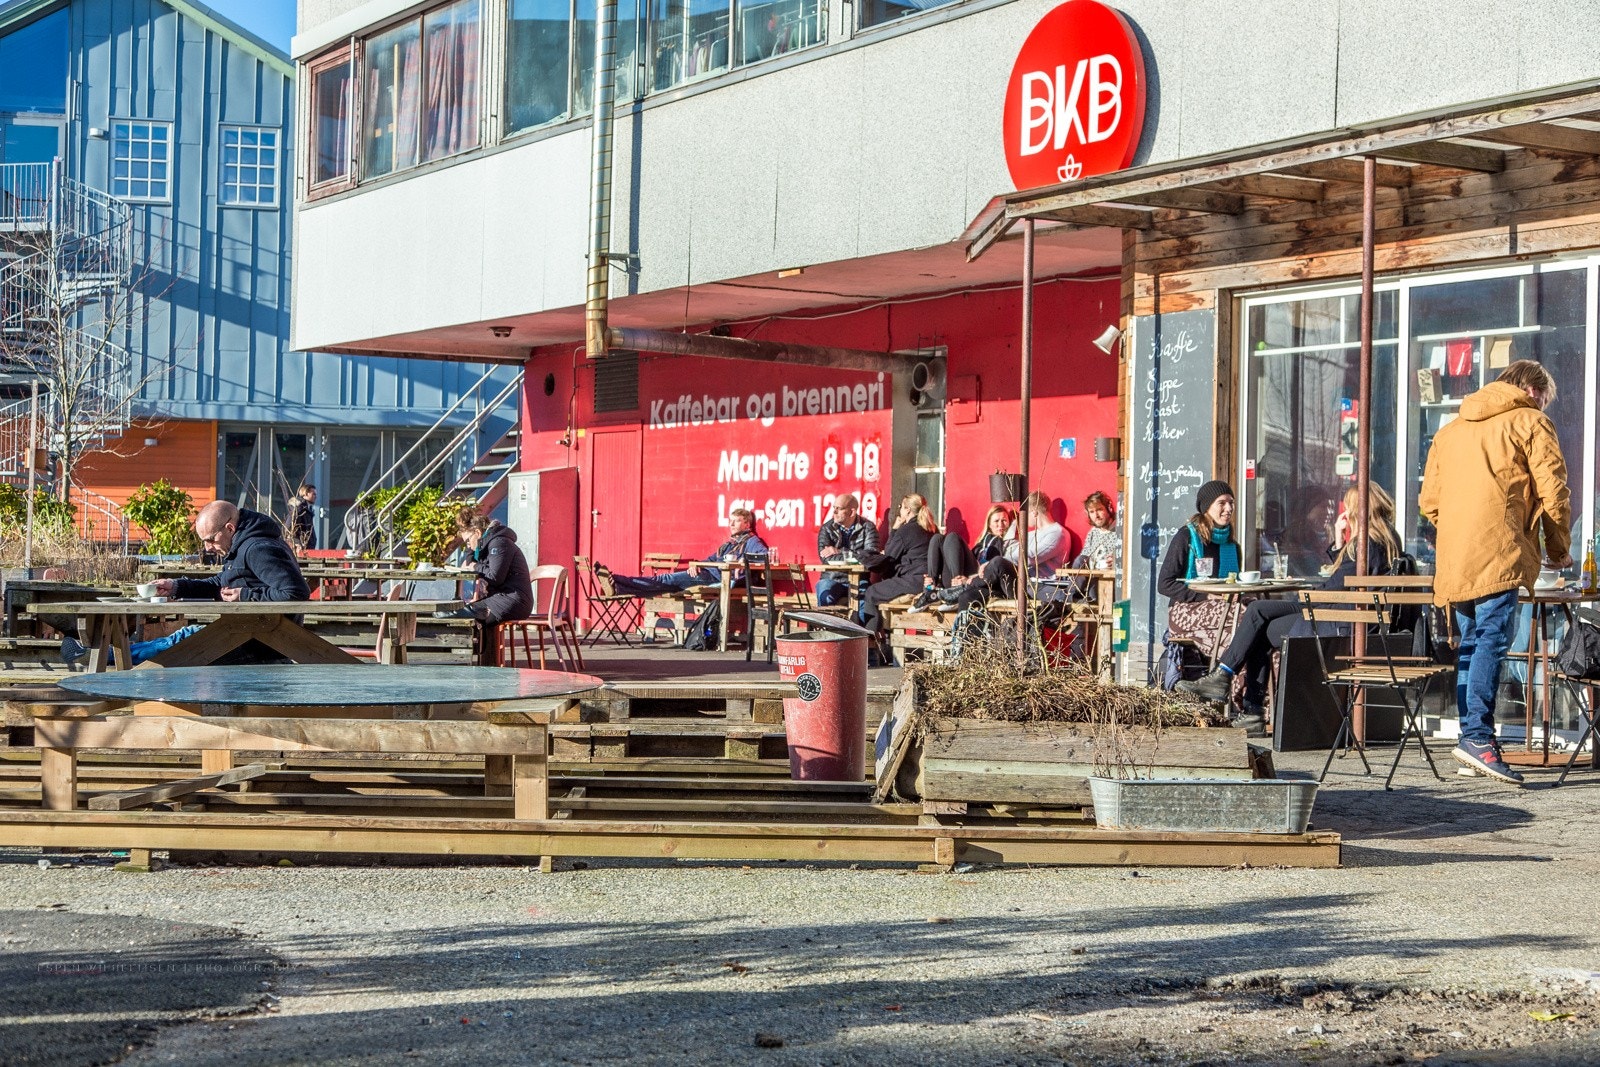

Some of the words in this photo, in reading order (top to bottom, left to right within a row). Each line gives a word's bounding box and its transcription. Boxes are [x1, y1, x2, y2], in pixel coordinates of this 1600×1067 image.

[1020, 54, 1122, 156] BKB
[1148, 330, 1199, 363] Kaffe
[649, 394, 741, 429] Kaffebar
[745, 392, 776, 427] og
[782, 372, 885, 417] brenneri
[717, 445, 809, 484] Man-fre
[823, 447, 838, 480] 8
